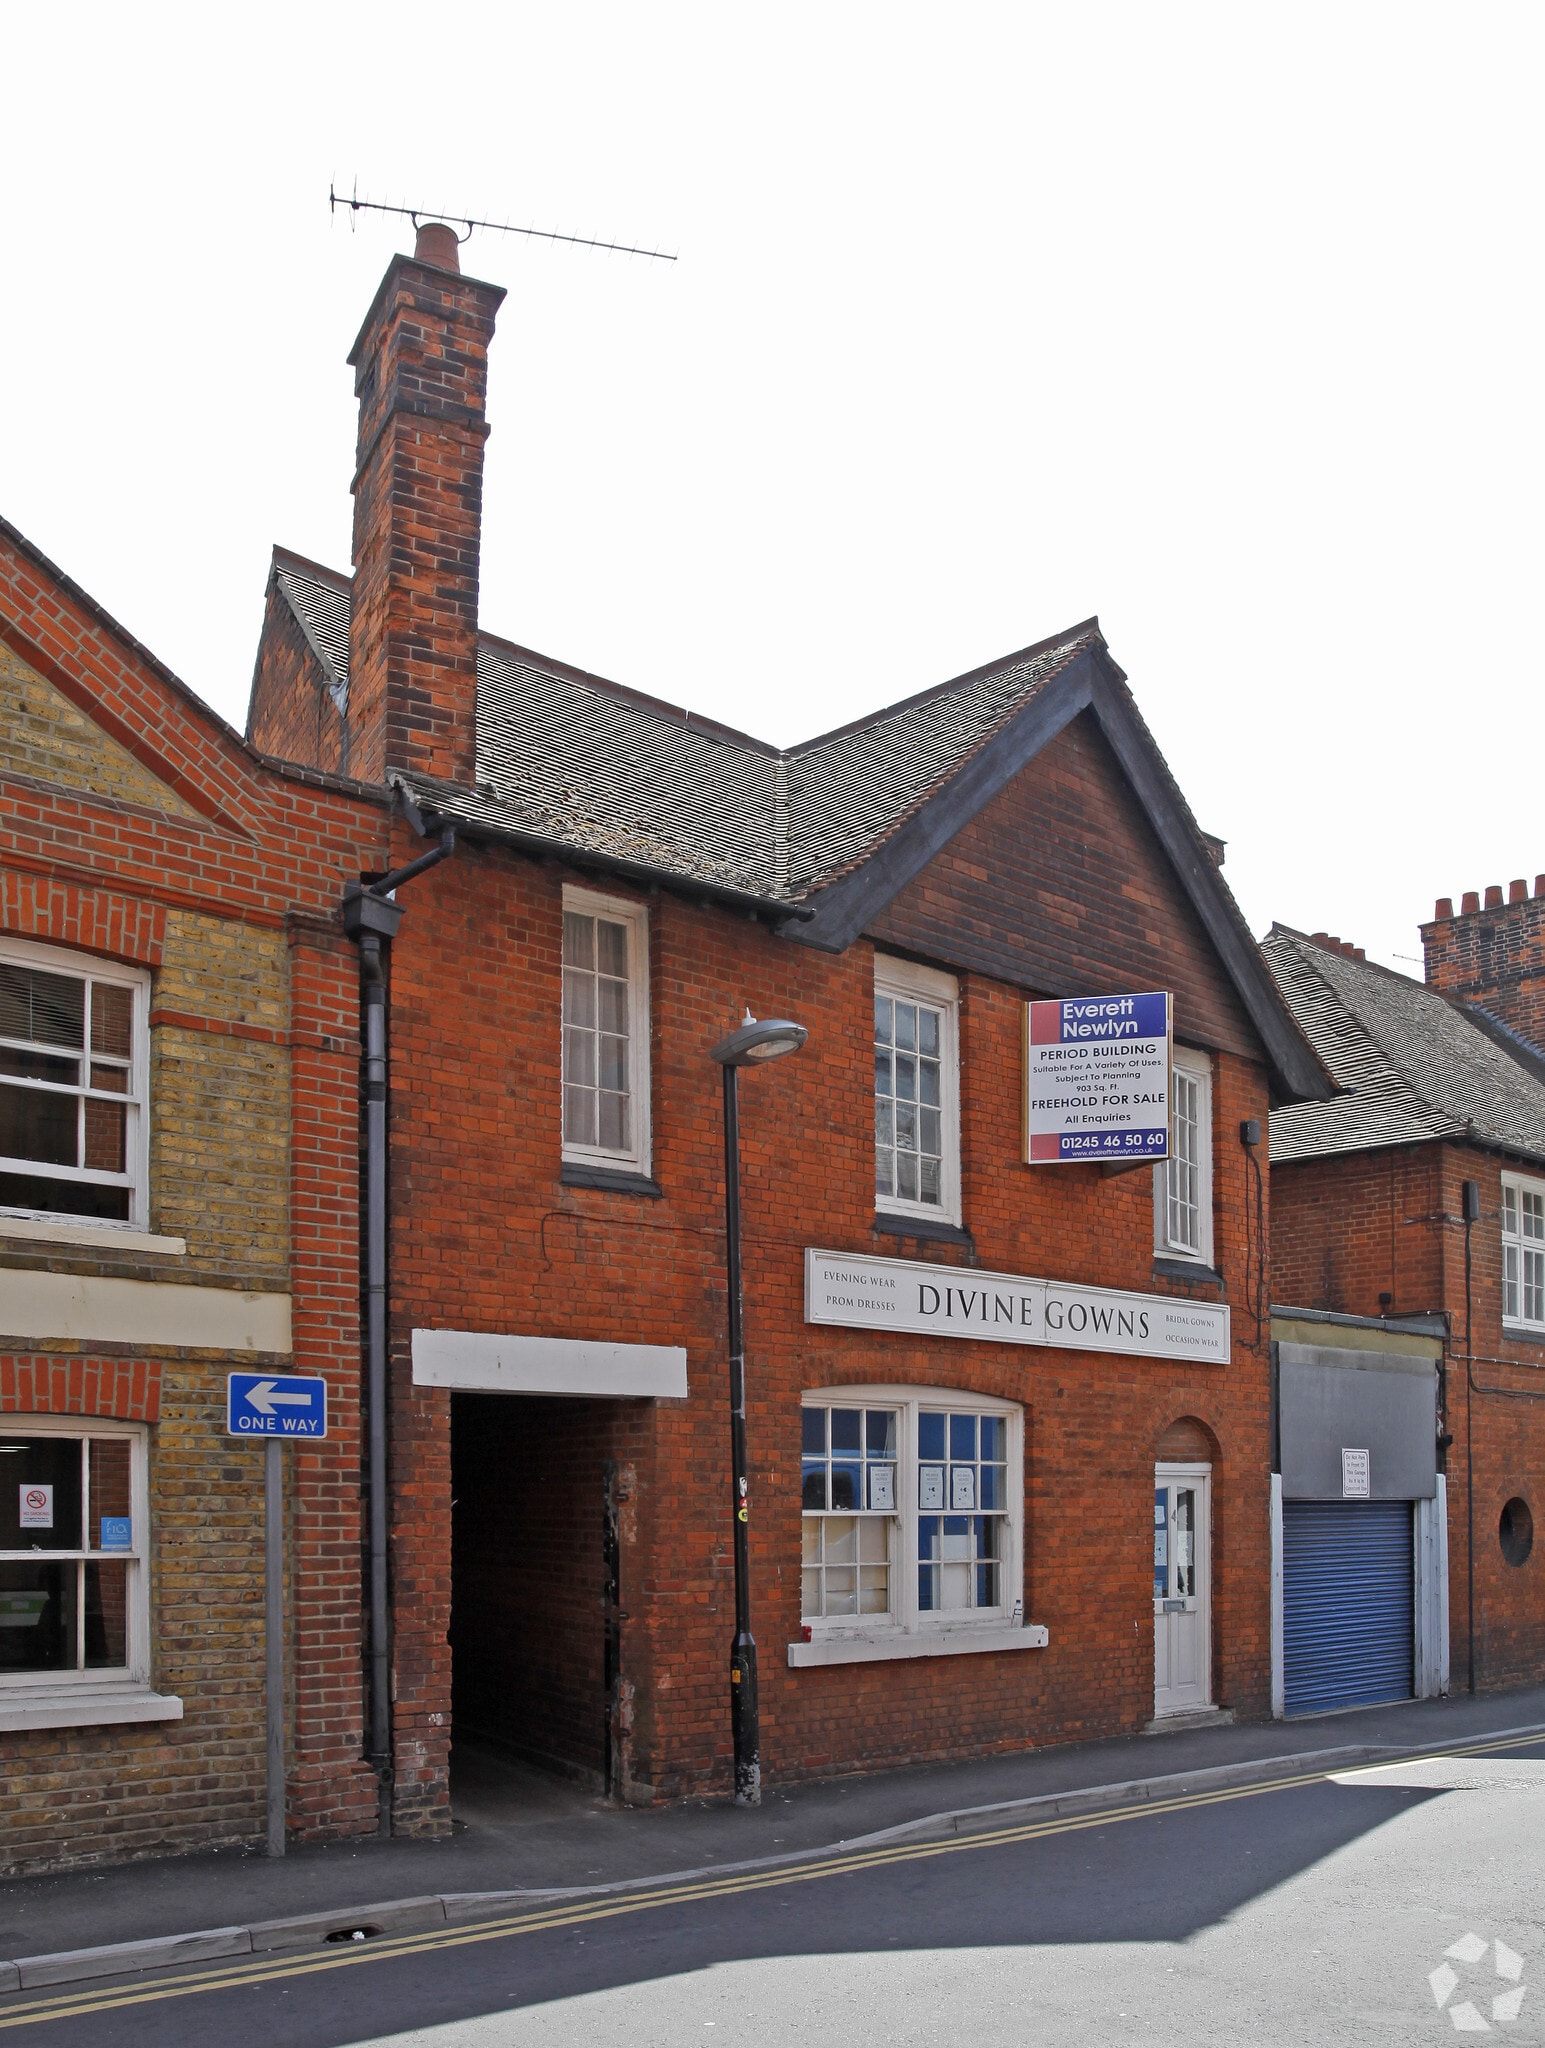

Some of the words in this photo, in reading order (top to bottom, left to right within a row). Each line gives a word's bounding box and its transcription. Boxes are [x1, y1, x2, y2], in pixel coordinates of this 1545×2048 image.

[1063, 999, 1134, 1018] Everett
[1063, 1019, 1138, 1037] Newlyn
[1041, 1049, 1088, 1060] PERIOD
[1094, 1044, 1156, 1056] BUILDING
[1033, 1065, 1067, 1073] Suitable
[1095, 1061, 1126, 1069] Variety
[1032, 1097, 1097, 1109] FREEHOLD
[1103, 1095, 1128, 1105] FOR
[1134, 1094, 1164, 1103] SALE
[1083, 1114, 1131, 1123] Enquiries
[1062, 1137, 1099, 1149] 01245
[1104, 1136, 1120, 1146] 46
[1125, 1135, 1142, 1145] 50
[1147, 1134, 1163, 1144] 60
[824, 1271, 867, 1285] EVENING
[871, 1277, 896, 1288] WEAR
[826, 1295, 854, 1307] PROM
[858, 1299, 895, 1311] DRESSES
[918, 1284, 1032, 1326] DIVINE
[1046, 1301, 1149, 1338] GOWNS
[1166, 1315, 1189, 1325] BRIDAL
[1191, 1318, 1215, 1328] GOWNS
[1166, 1335, 1200, 1345] OCCASION
[1202, 1337, 1219, 1347] WEAR
[239, 1416, 275, 1430] ONE
[283, 1418, 318, 1431] WAY
[1171, 1509, 1176, 1522] 4
